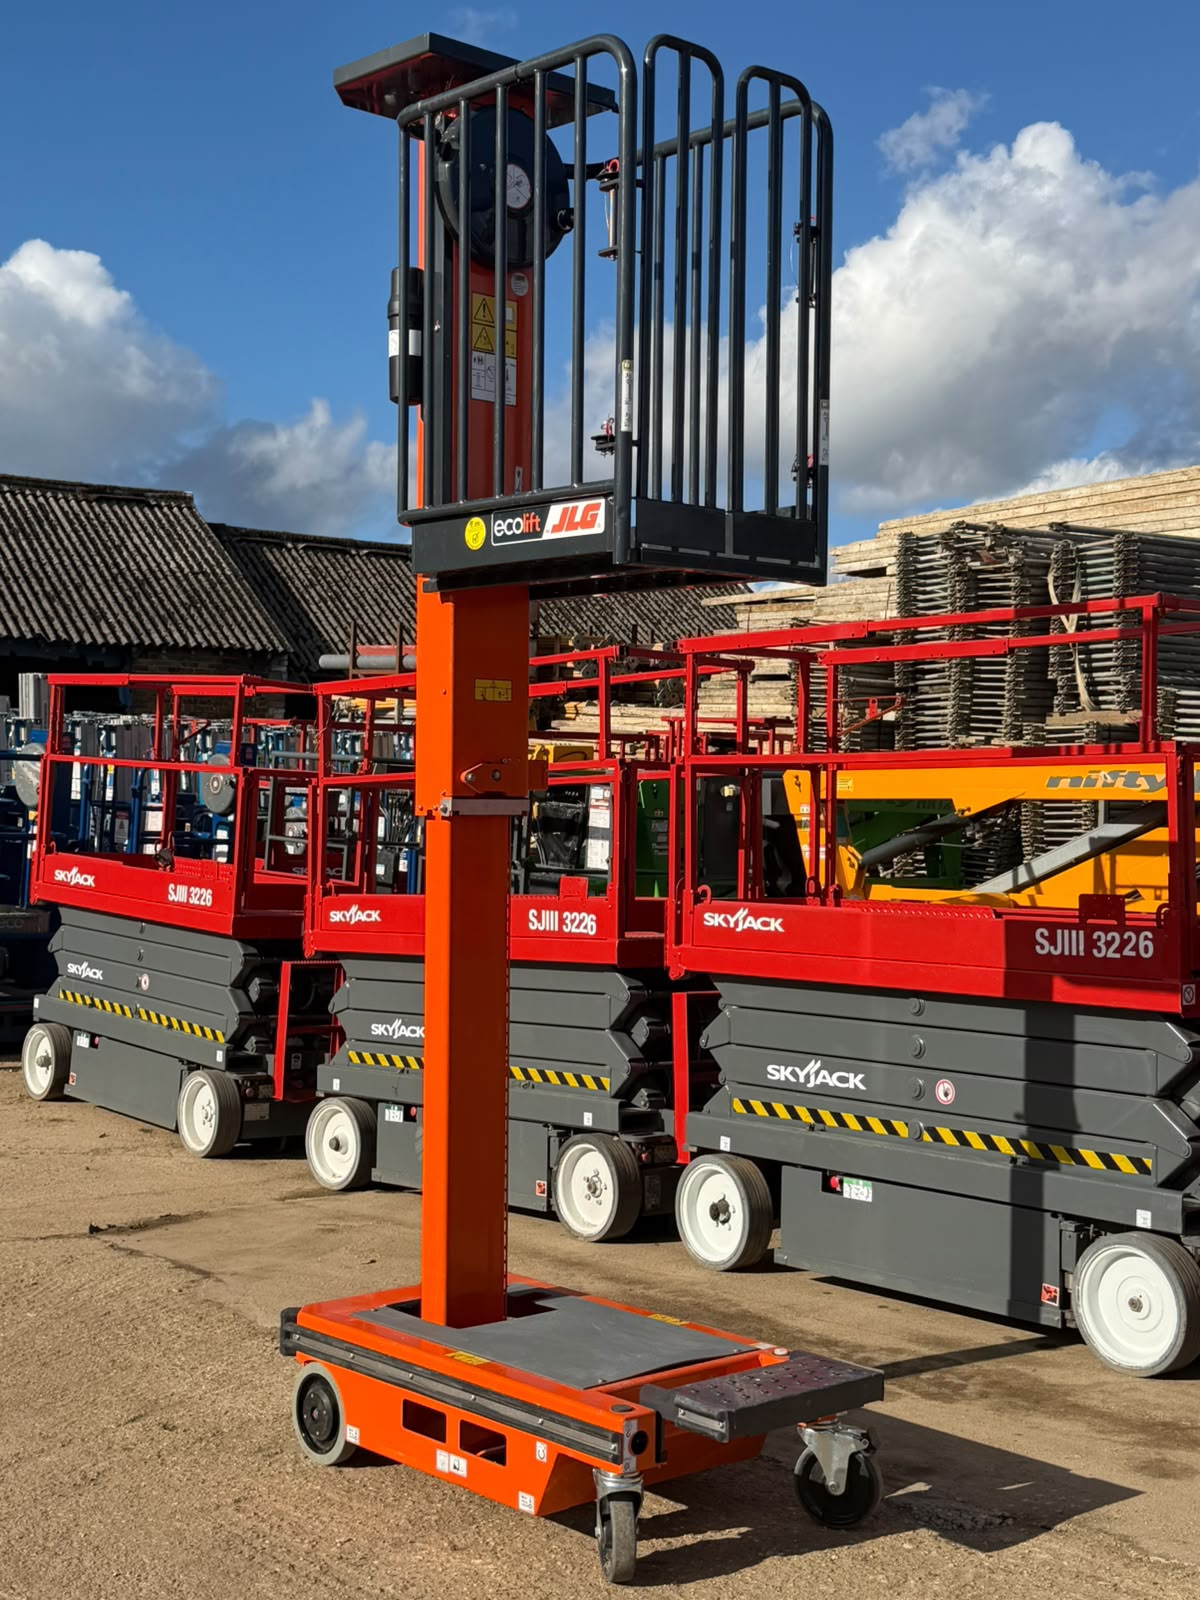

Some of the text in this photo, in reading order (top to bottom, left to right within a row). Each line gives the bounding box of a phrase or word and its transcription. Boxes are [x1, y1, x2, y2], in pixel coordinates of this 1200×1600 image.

[494, 511, 541, 537] ecolift
[550, 502, 602, 534] JLG
[54, 866, 96, 888] SKYJACK
[168, 883, 213, 907] SJIII 3226
[329, 904, 382, 925] SKYJACK
[528, 909, 597, 935] SJIII 3226
[703, 907, 784, 933] SKYJACK
[1035, 928, 1154, 959] SJIII 3226
[67, 961, 103, 980] SKYJACK
[371, 1018, 425, 1040] SKYJACK
[766, 1059, 867, 1090] SKYJACK
